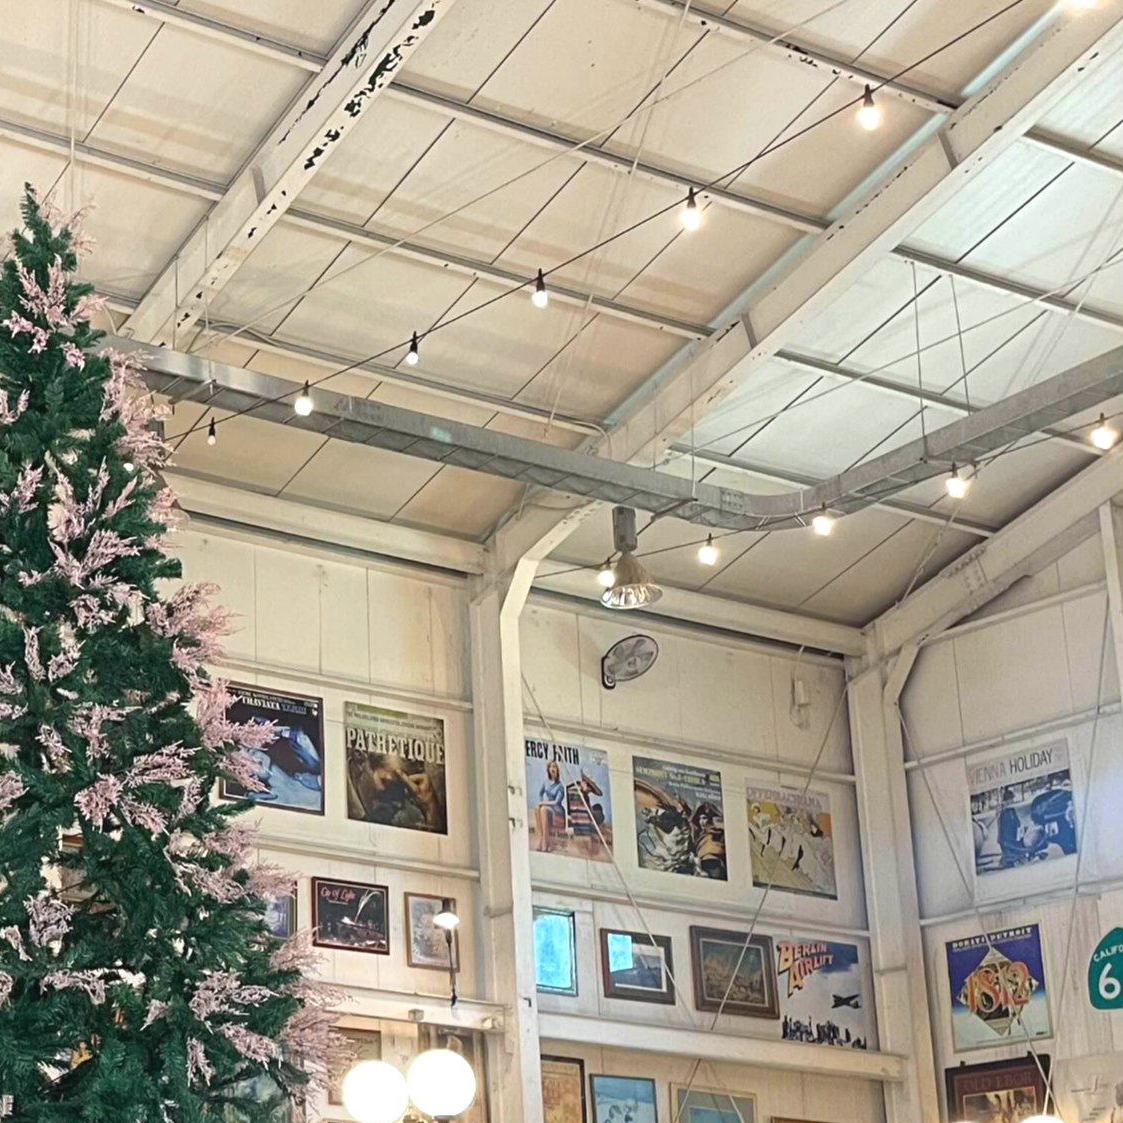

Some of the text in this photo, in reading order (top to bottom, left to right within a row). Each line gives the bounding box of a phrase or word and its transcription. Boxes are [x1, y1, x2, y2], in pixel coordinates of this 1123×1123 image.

[346, 727, 445, 765] PATHETIQUE
[525, 740, 580, 765] ERCY FAITH
[968, 748, 1053, 785] VIENNA HOLIDAY
[776, 941, 828, 976] BERLIN
[787, 954, 834, 998] AIRLIFT
[1098, 962, 1121, 1000] 6
